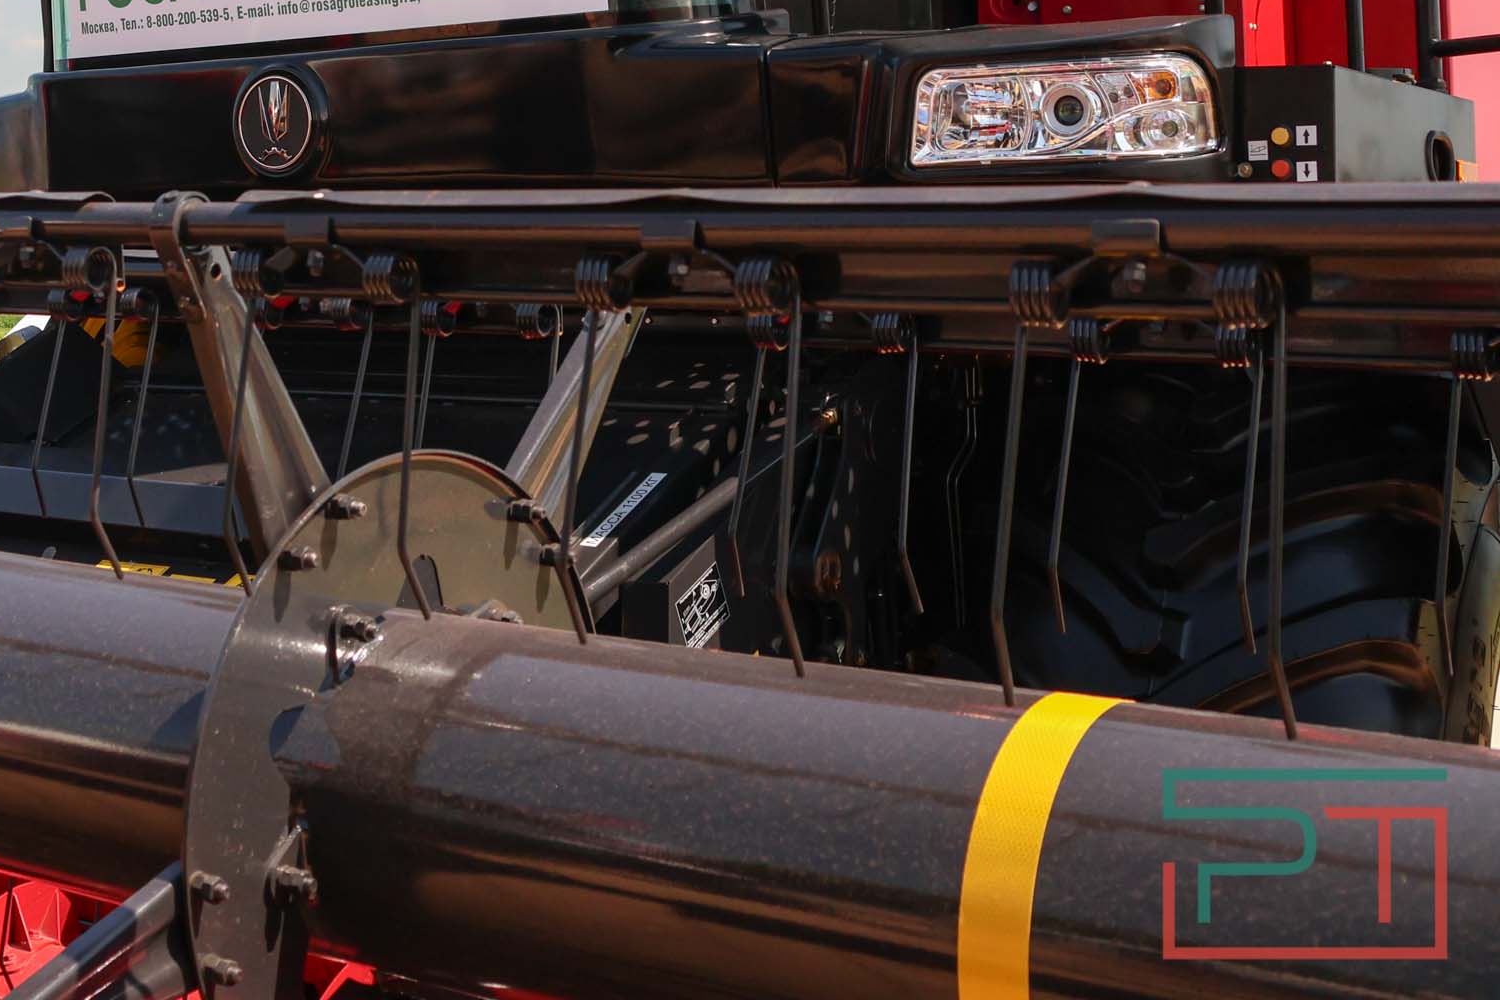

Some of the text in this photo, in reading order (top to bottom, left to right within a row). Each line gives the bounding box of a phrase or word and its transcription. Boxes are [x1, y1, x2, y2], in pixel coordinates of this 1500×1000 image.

[81, 21, 118, 35] Москва,
[121, 17, 144, 31] Тел.:
[146, 7, 234, 28] 8-800-200-539-5,
[237, 4, 275, 19] E-mail:
[586, 511, 627, 545] МАССА
[622, 489, 648, 509] 1100
